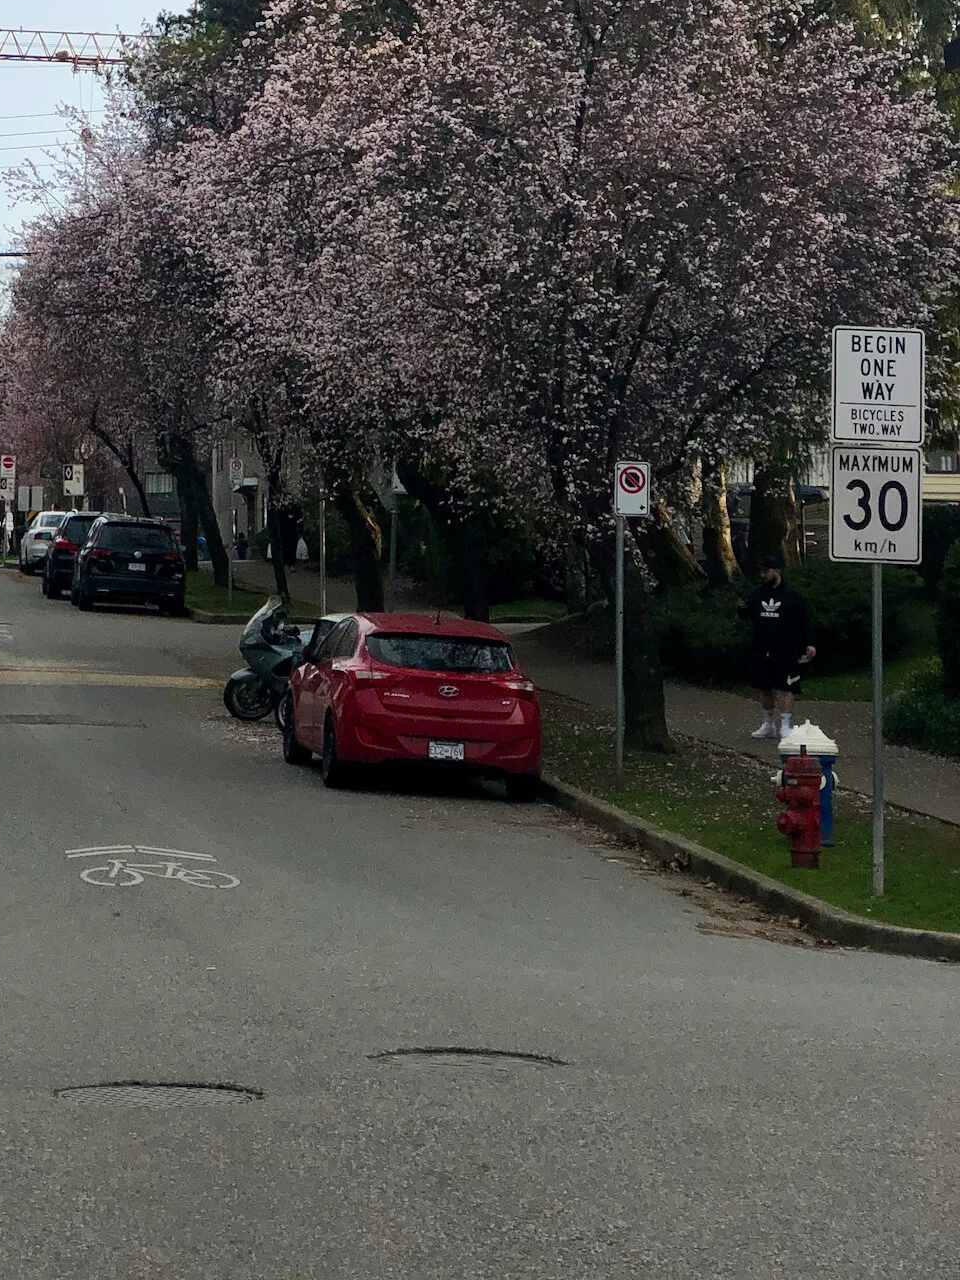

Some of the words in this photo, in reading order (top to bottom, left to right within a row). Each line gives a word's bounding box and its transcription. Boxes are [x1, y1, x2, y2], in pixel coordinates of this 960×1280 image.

[851, 334, 906, 355] BEGIN
[860, 358, 897, 377] ONE
[861, 381, 895, 401] WAY
[851, 408, 904, 422] BICYCLES
[853, 422, 875, 435] TWO
[881, 424, 902, 436] WAY
[839, 454, 913, 473] MAXIMUM
[843, 478, 909, 532] 30
[854, 538, 897, 554] km/h
